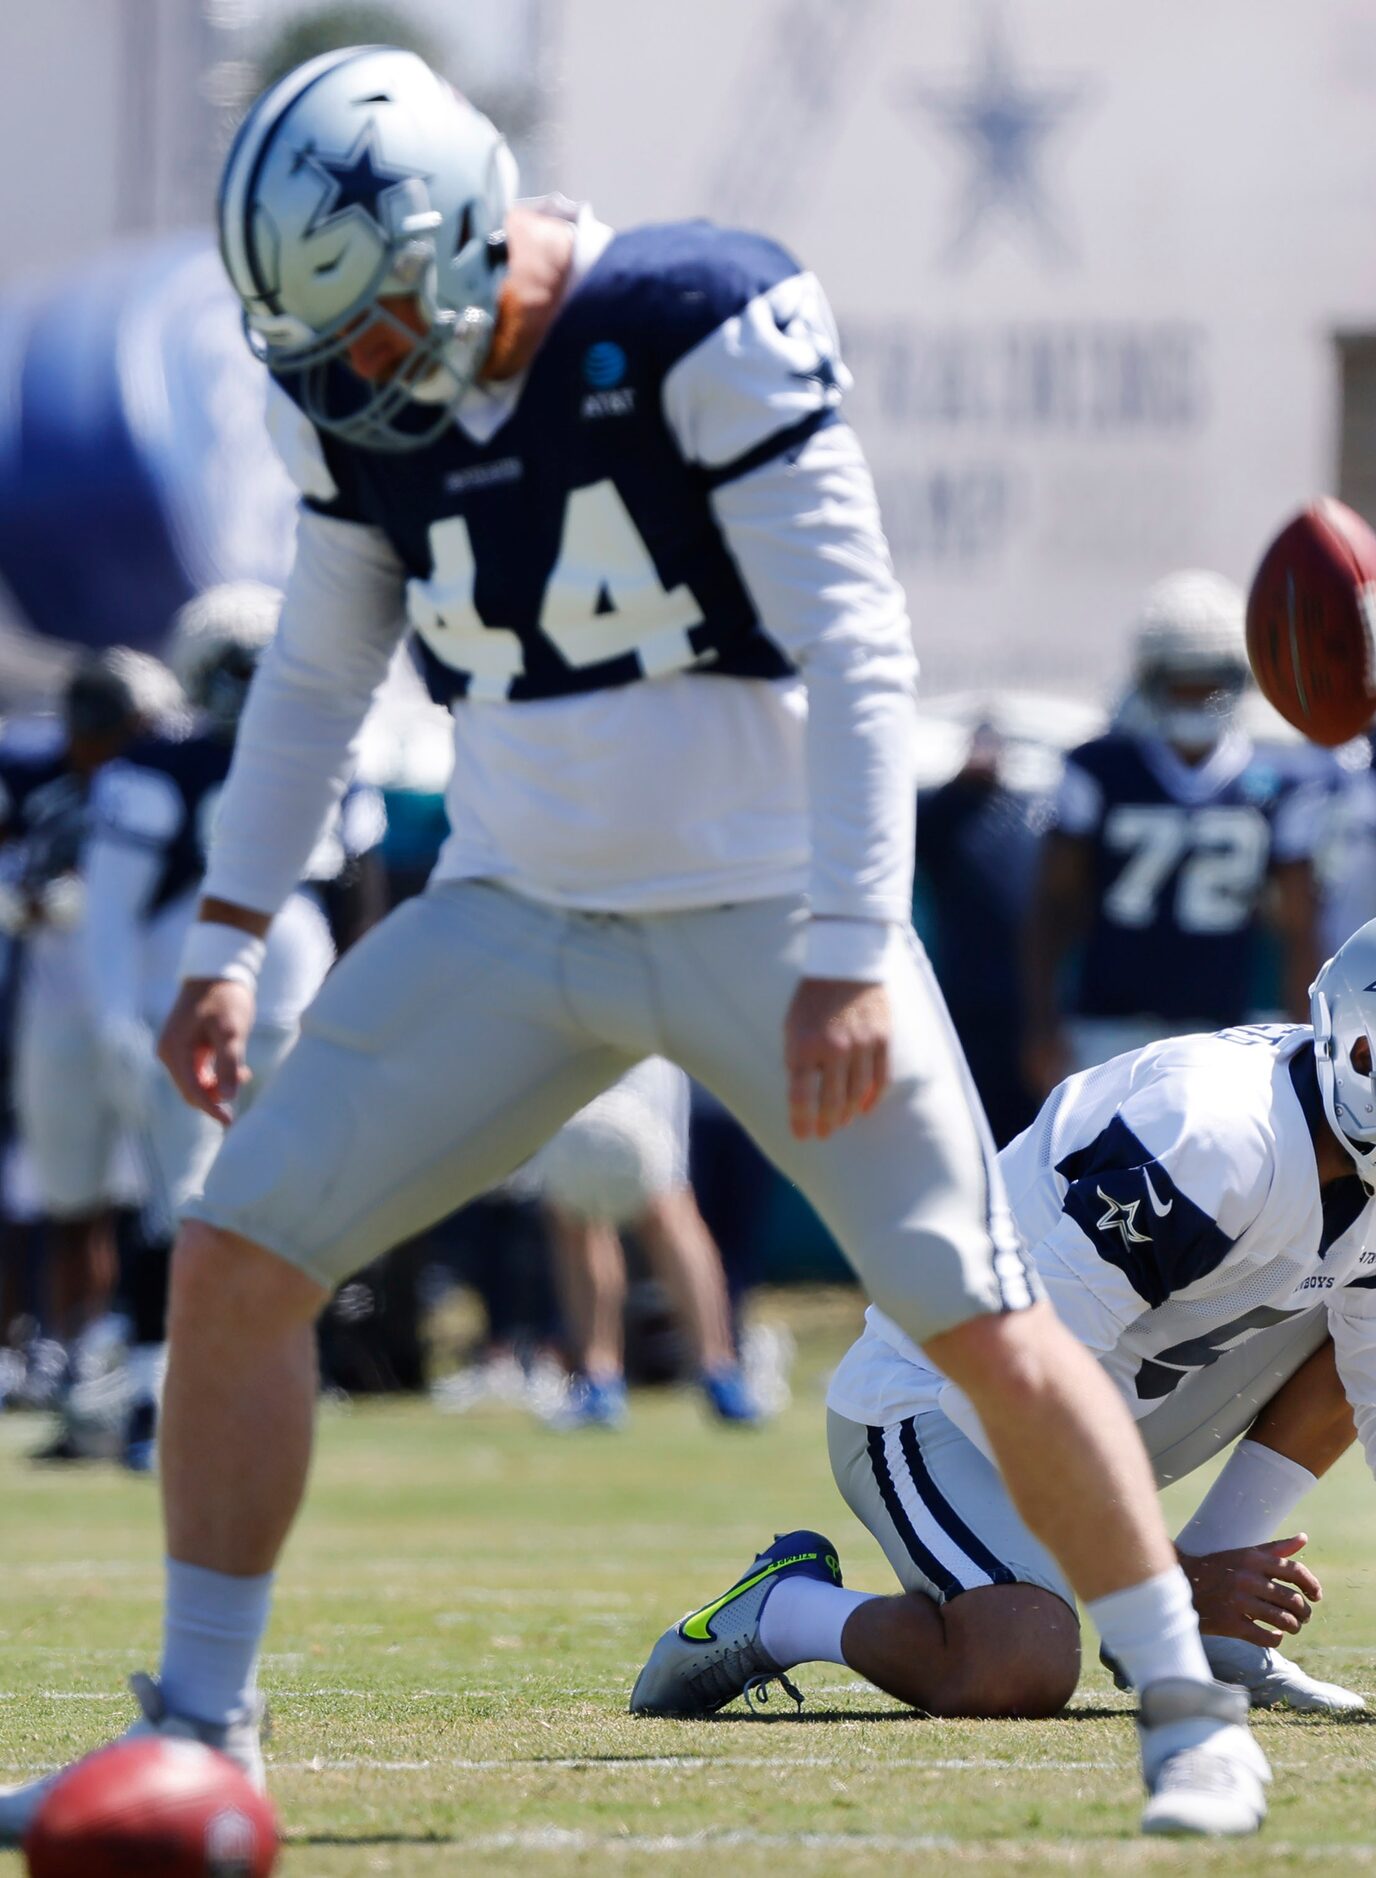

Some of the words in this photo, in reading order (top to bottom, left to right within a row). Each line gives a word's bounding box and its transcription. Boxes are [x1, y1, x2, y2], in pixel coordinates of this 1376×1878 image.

[581, 387, 636, 418] AT&T
[406, 477, 706, 700] 44
[1103, 803, 1272, 934] 72
